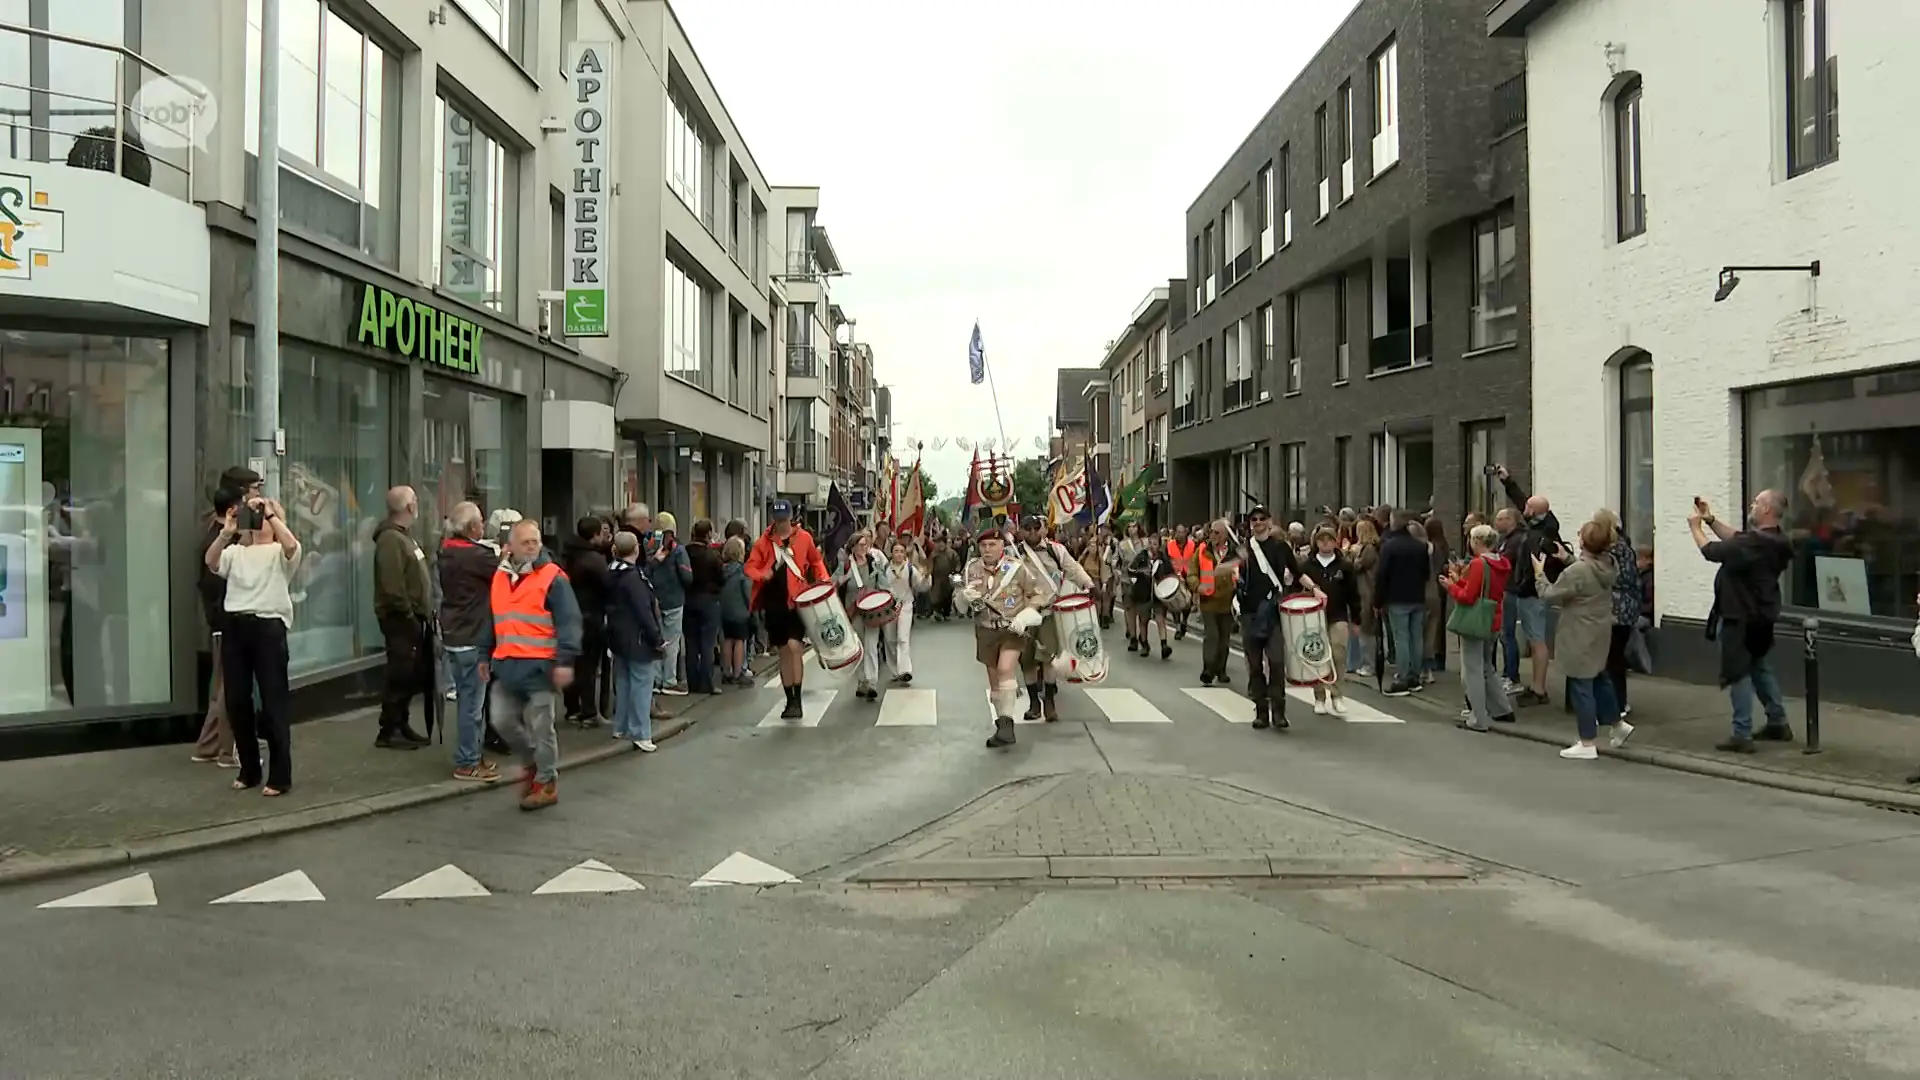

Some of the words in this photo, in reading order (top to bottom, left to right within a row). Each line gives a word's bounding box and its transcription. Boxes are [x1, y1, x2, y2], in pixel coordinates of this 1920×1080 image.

[573, 48, 603, 283] APOTHEEK
[358, 283, 483, 374] APOTHEEK
[567, 324, 604, 333] DASSEN
